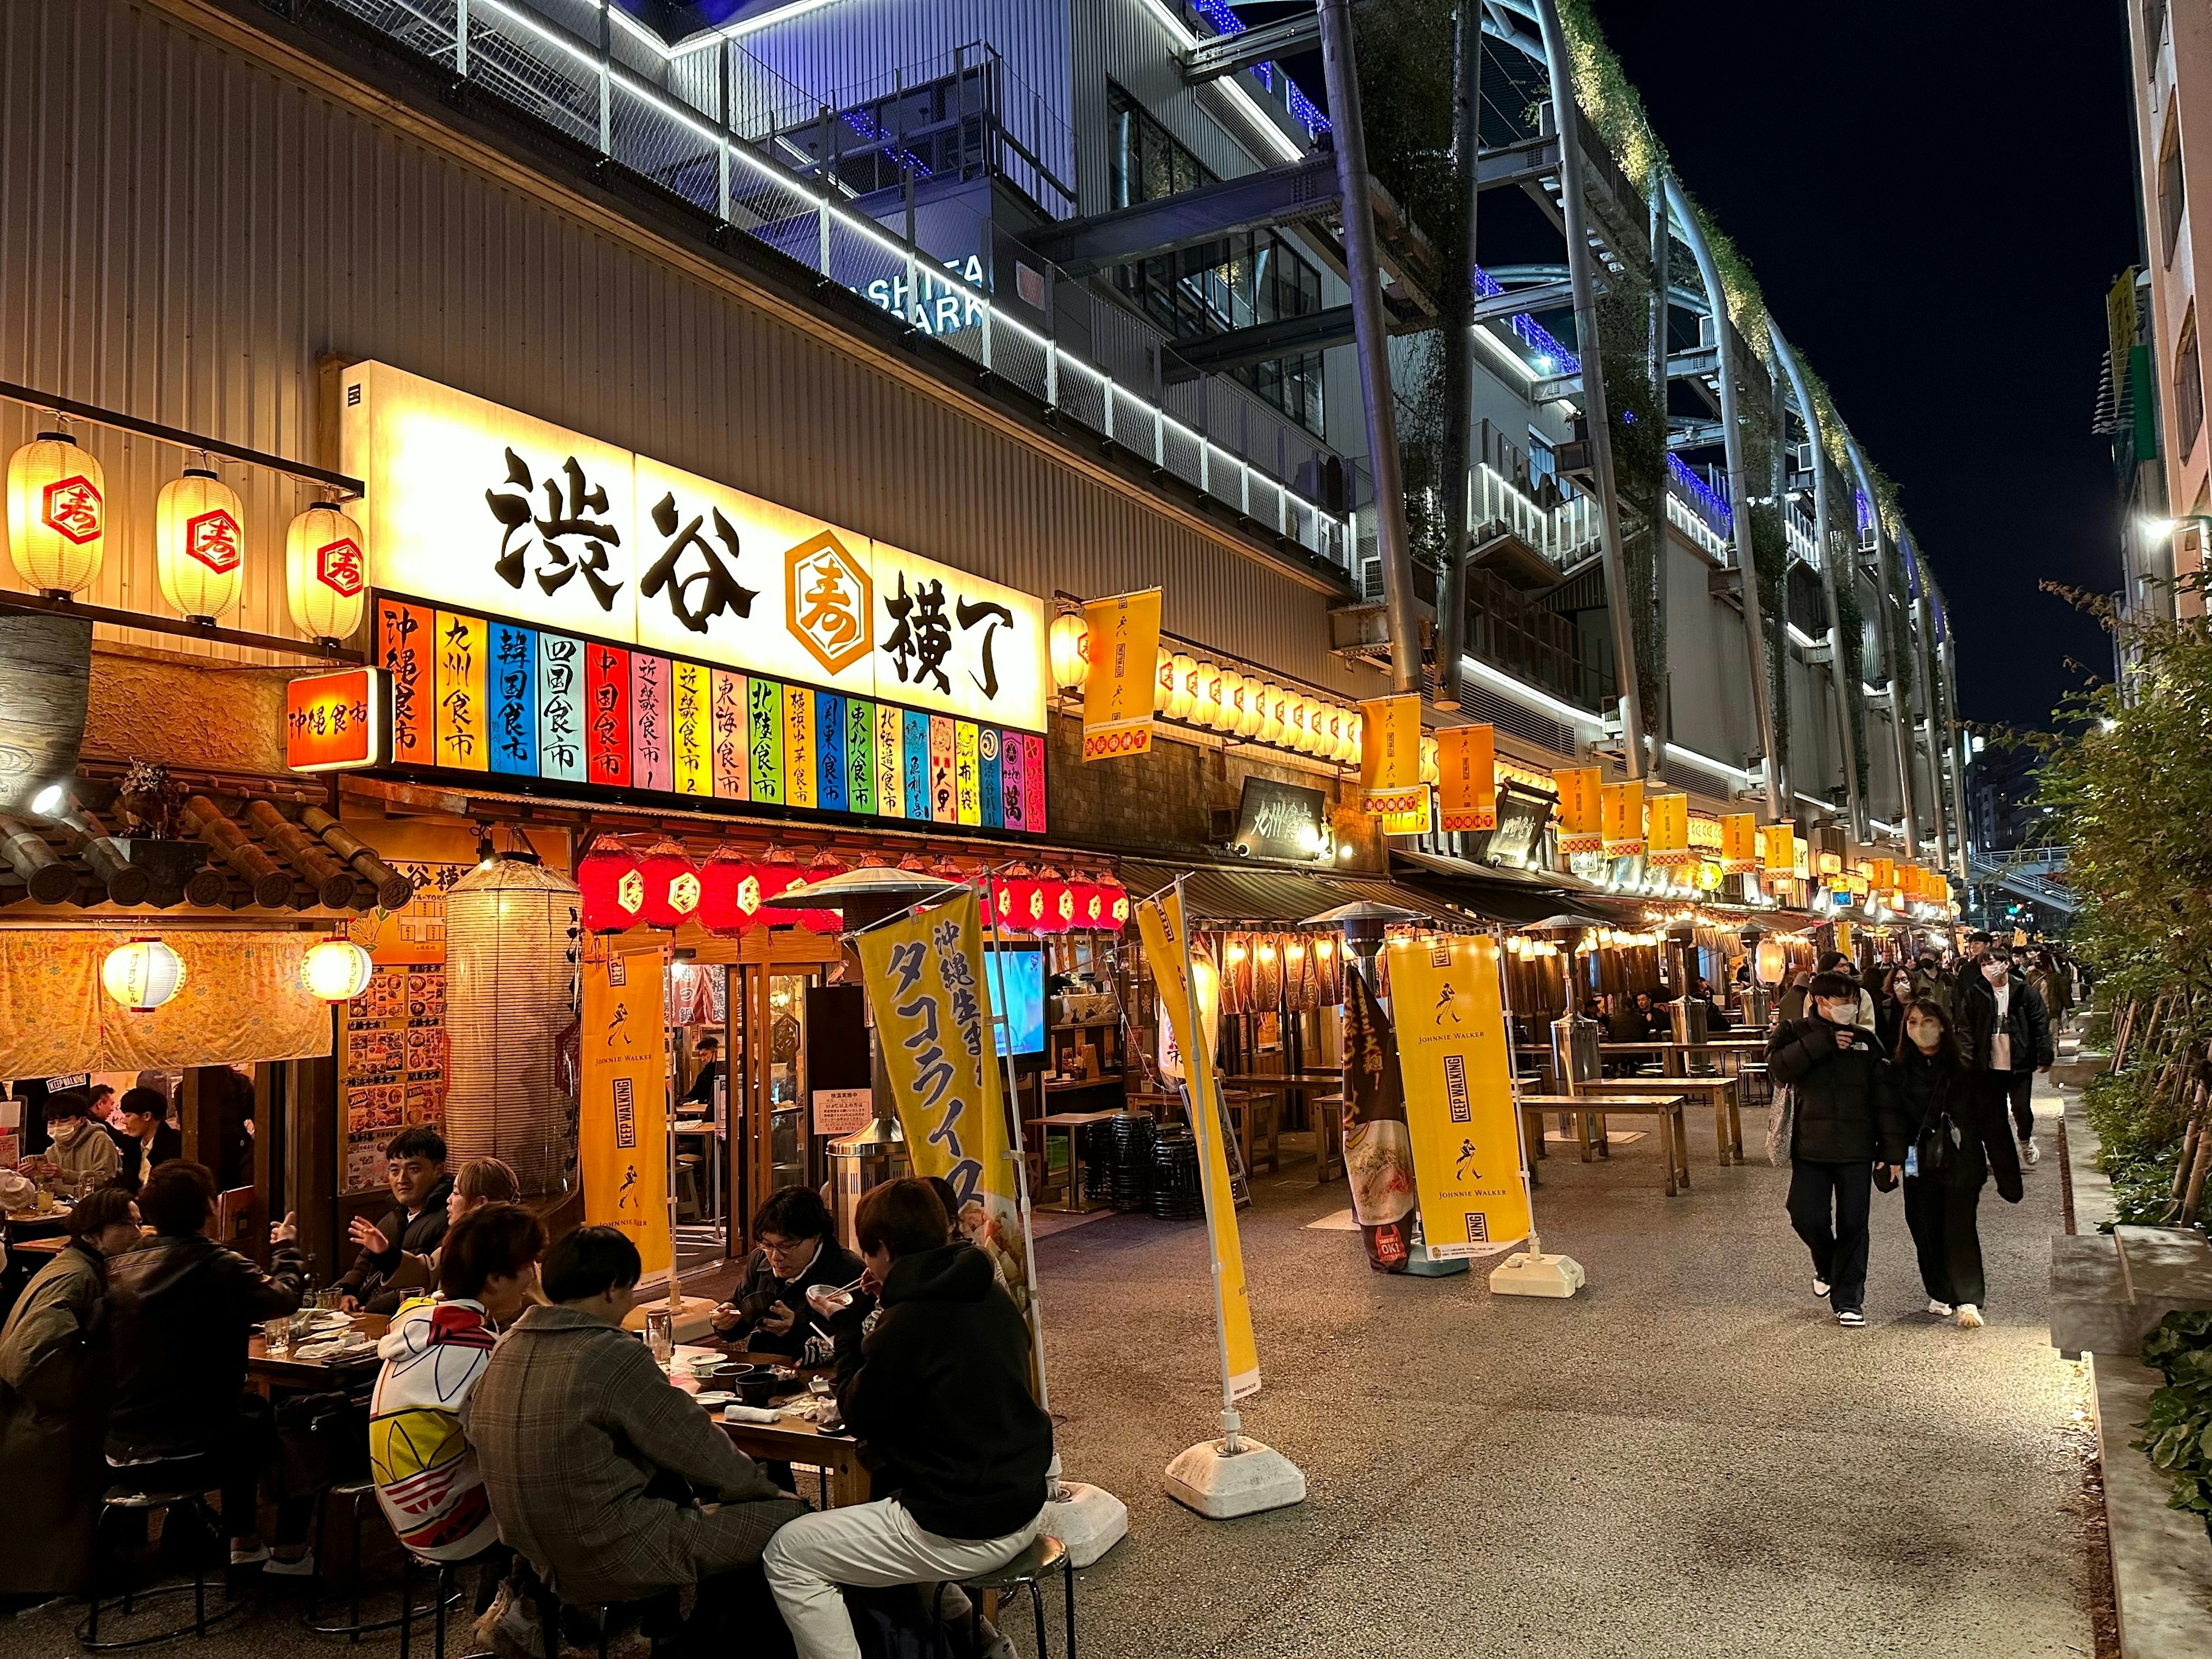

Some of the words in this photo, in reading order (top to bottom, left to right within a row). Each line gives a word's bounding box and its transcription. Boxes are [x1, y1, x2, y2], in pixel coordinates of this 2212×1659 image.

[485, 446, 760, 634] 渋谷
[880, 570, 1013, 700] 横丁
[288, 700, 368, 740] 沖縄食市
[384, 607, 424, 759] 沖縄食市
[442, 616, 475, 764] 九州食市
[497, 629, 531, 770] 韓国食市
[543, 638, 579, 777] 四国食市
[593, 648, 624, 782] 中国食市
[715, 675, 740, 797] 東海食市
[752, 681, 777, 802] 北陸食市
[790, 690, 808, 804] 横浜中華食市
[821, 696, 840, 807] 関東食市
[850, 703, 869, 810] 東北食市
[880, 708, 898, 813] 北海道食市
[958, 760, 973, 810] 布袋
[984, 763, 998, 826] 渋谷バル
[611, 963, 623, 983] KEEP
[934, 921, 982, 1086] 沖縄生ま
[887, 943, 984, 1207] タコライス
[1418, 1034, 1451, 1044] JOHNNIE
[1453, 1031, 1484, 1041] WALKER
[1448, 1057, 1465, 1090] WALKING
[617, 1081, 632, 1122] WALKING
[620, 1123, 632, 1145] KEEP
[1453, 1092, 1468, 1120] KEEP
[1438, 1191, 1472, 1200] JOHNNIE
[1474, 1189, 1507, 1198] WALKER
[1381, 1244, 1400, 1254] OK!
